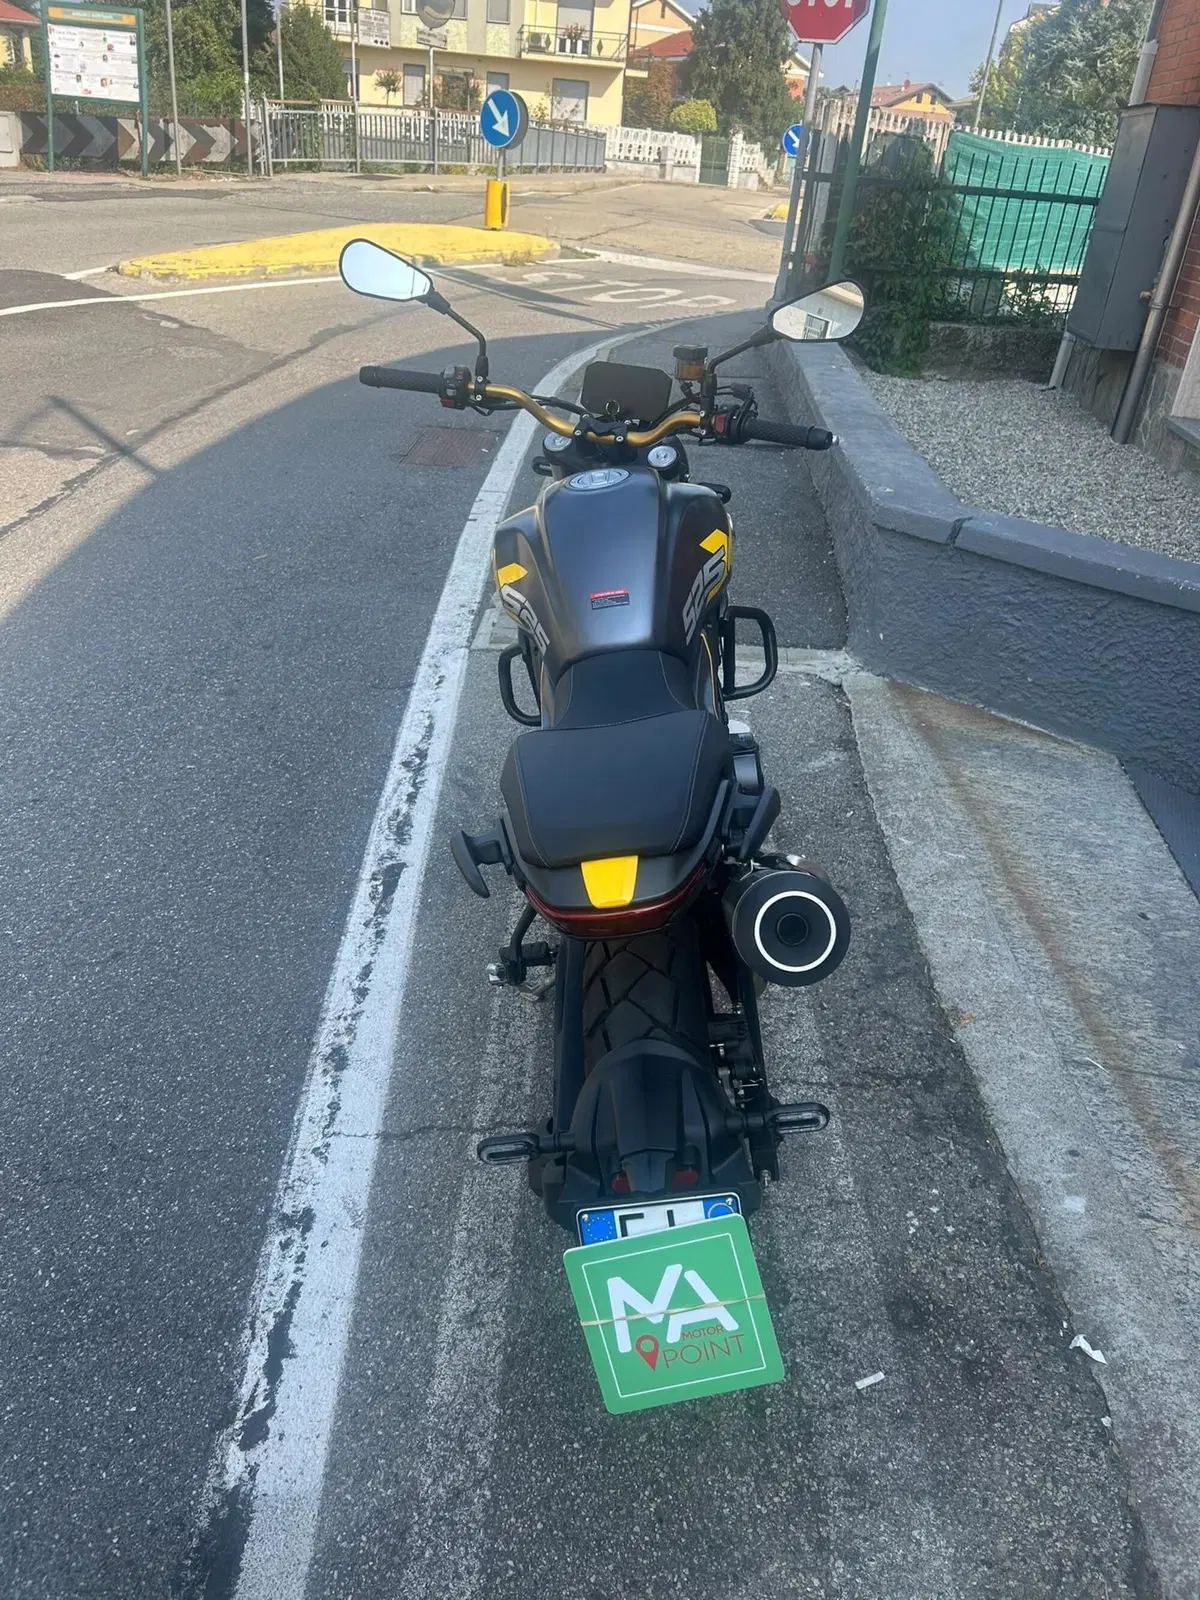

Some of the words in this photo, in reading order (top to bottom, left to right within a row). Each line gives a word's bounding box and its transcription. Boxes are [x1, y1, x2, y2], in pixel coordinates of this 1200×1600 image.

[485, 271, 736, 309] STOP
[500, 584, 550, 656] 525
[682, 545, 725, 646] 525
[607, 1263, 739, 1353] MA
[681, 1324, 725, 1341] MOTOR
[662, 1333, 745, 1369] POINT
